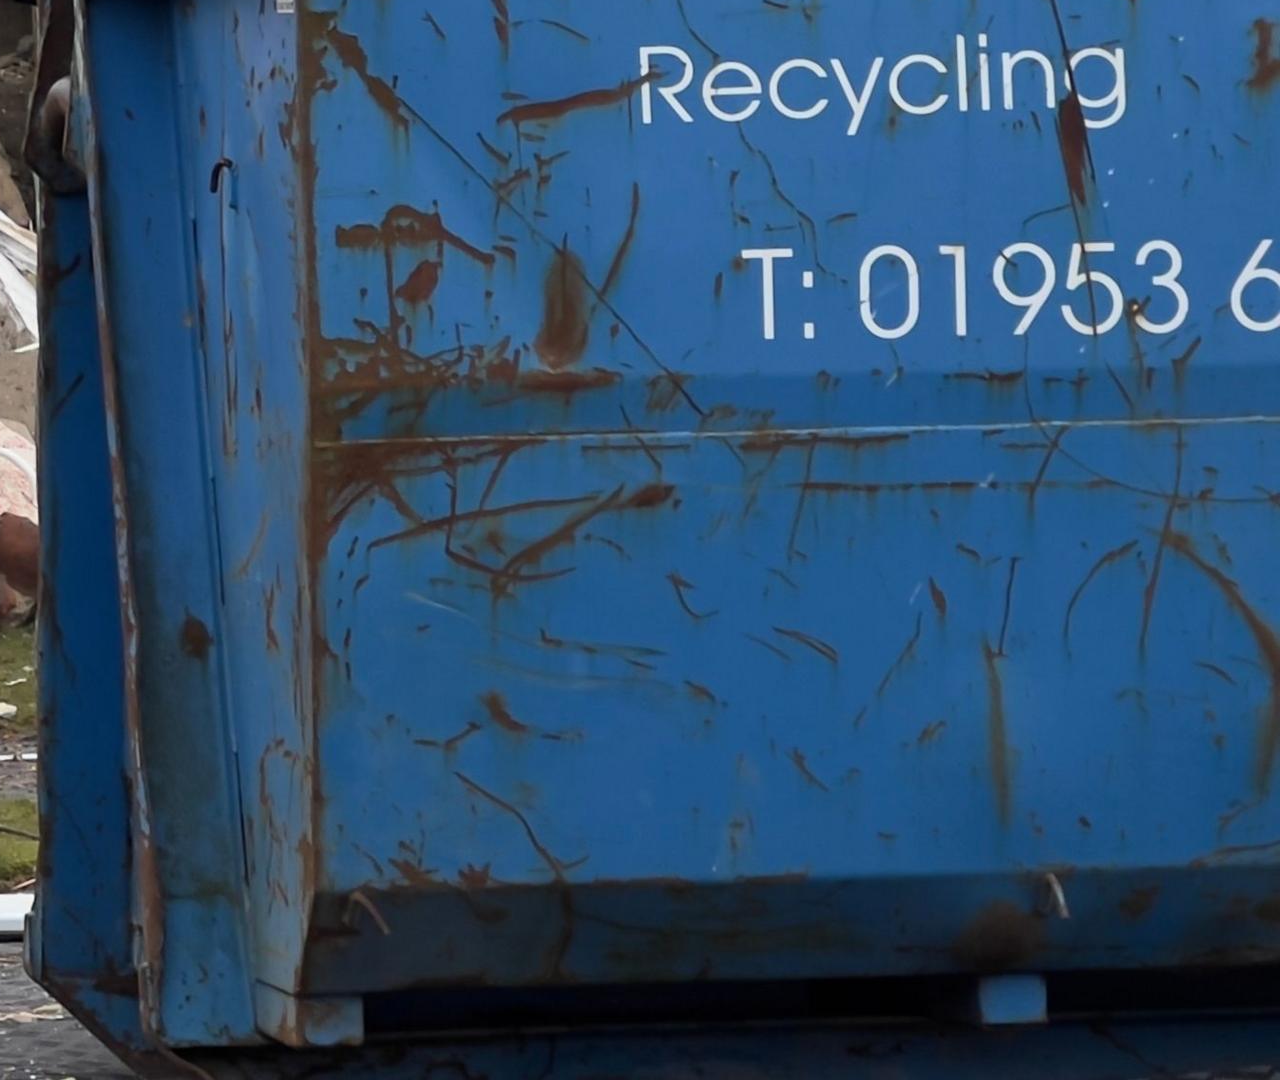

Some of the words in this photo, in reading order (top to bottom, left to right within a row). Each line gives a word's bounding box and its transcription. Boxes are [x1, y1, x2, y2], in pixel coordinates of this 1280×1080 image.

[639, 33, 1127, 136] Recycling
[741, 248, 815, 339] T:
[859, 239, 1189, 339] 01953
